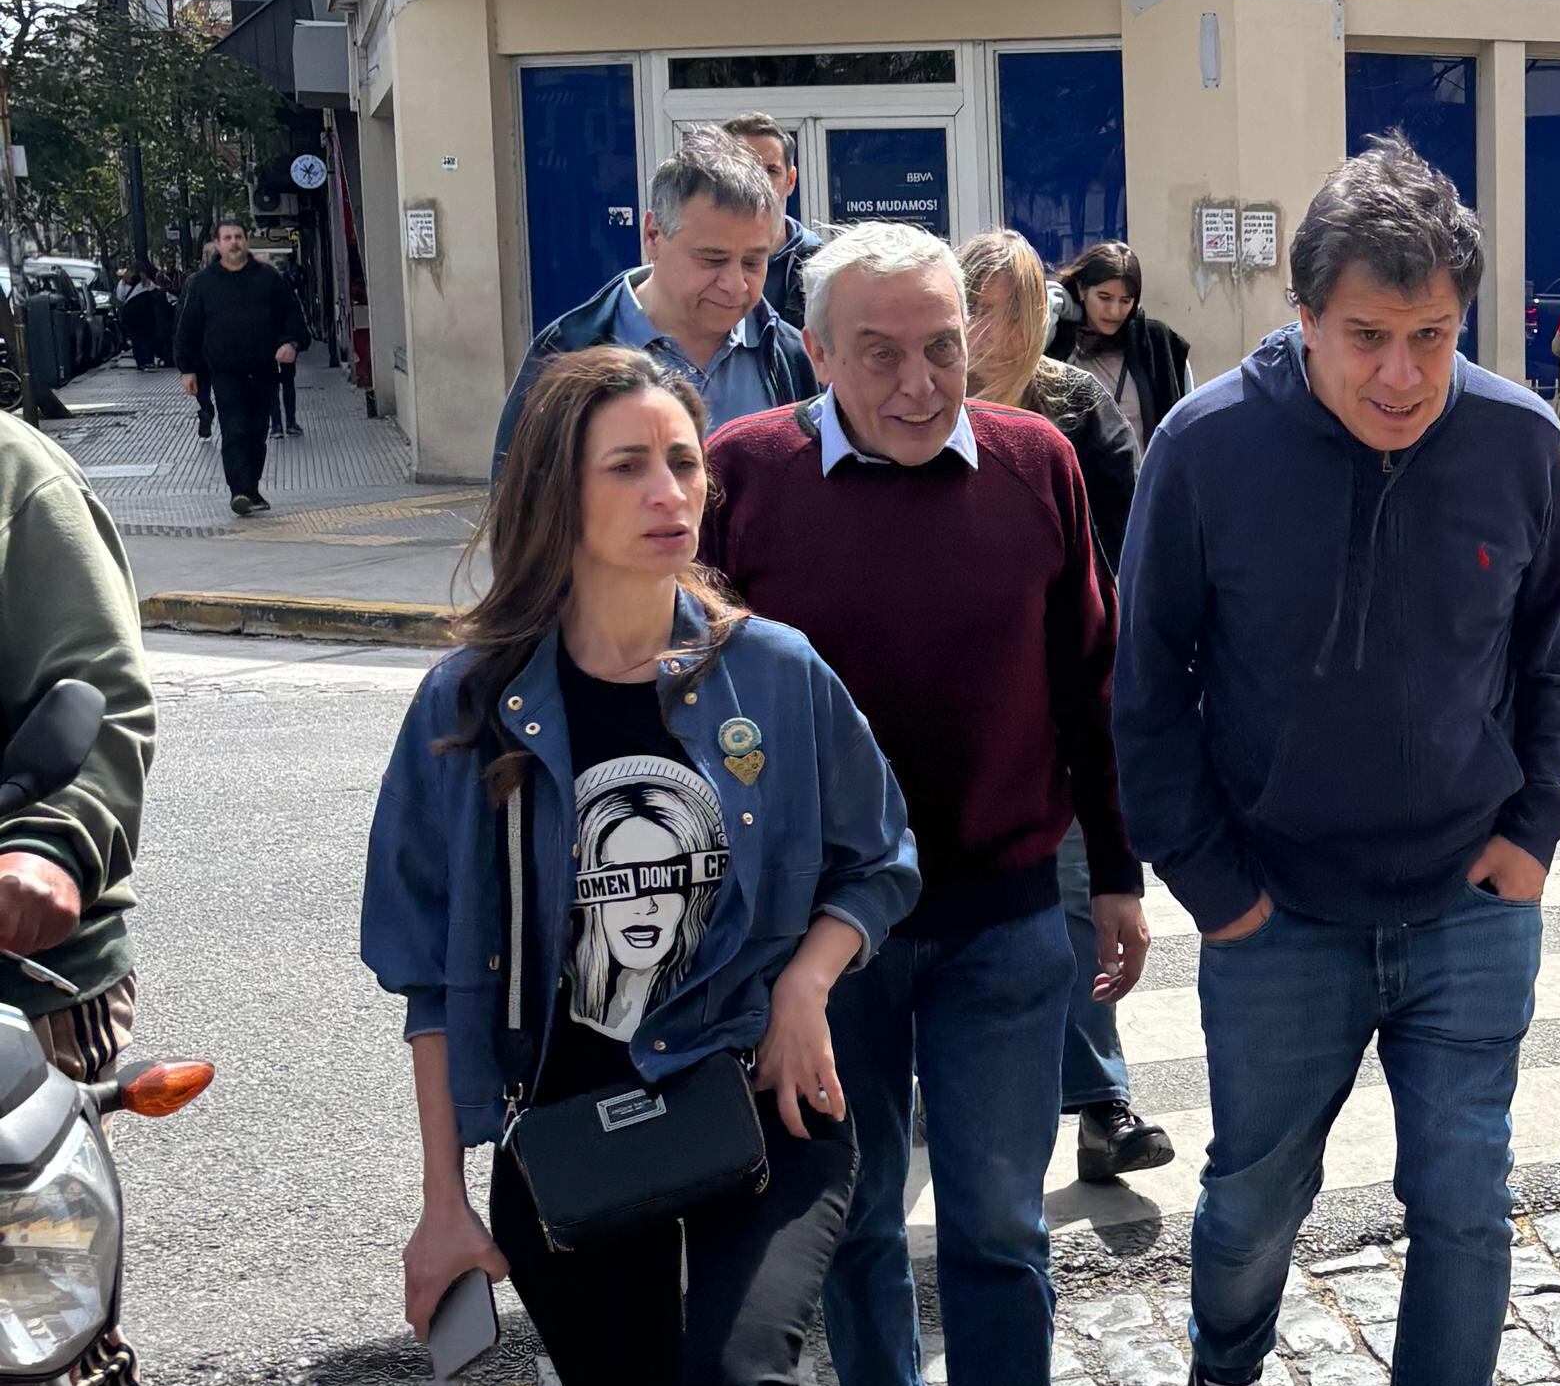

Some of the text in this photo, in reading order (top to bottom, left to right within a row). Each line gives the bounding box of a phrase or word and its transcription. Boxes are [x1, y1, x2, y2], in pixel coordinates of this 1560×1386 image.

[906, 172, 934, 183] BBVA
[876, 199, 938, 212] MUDAMOS!
[577, 853, 730, 899] OMEN DON'T CR
